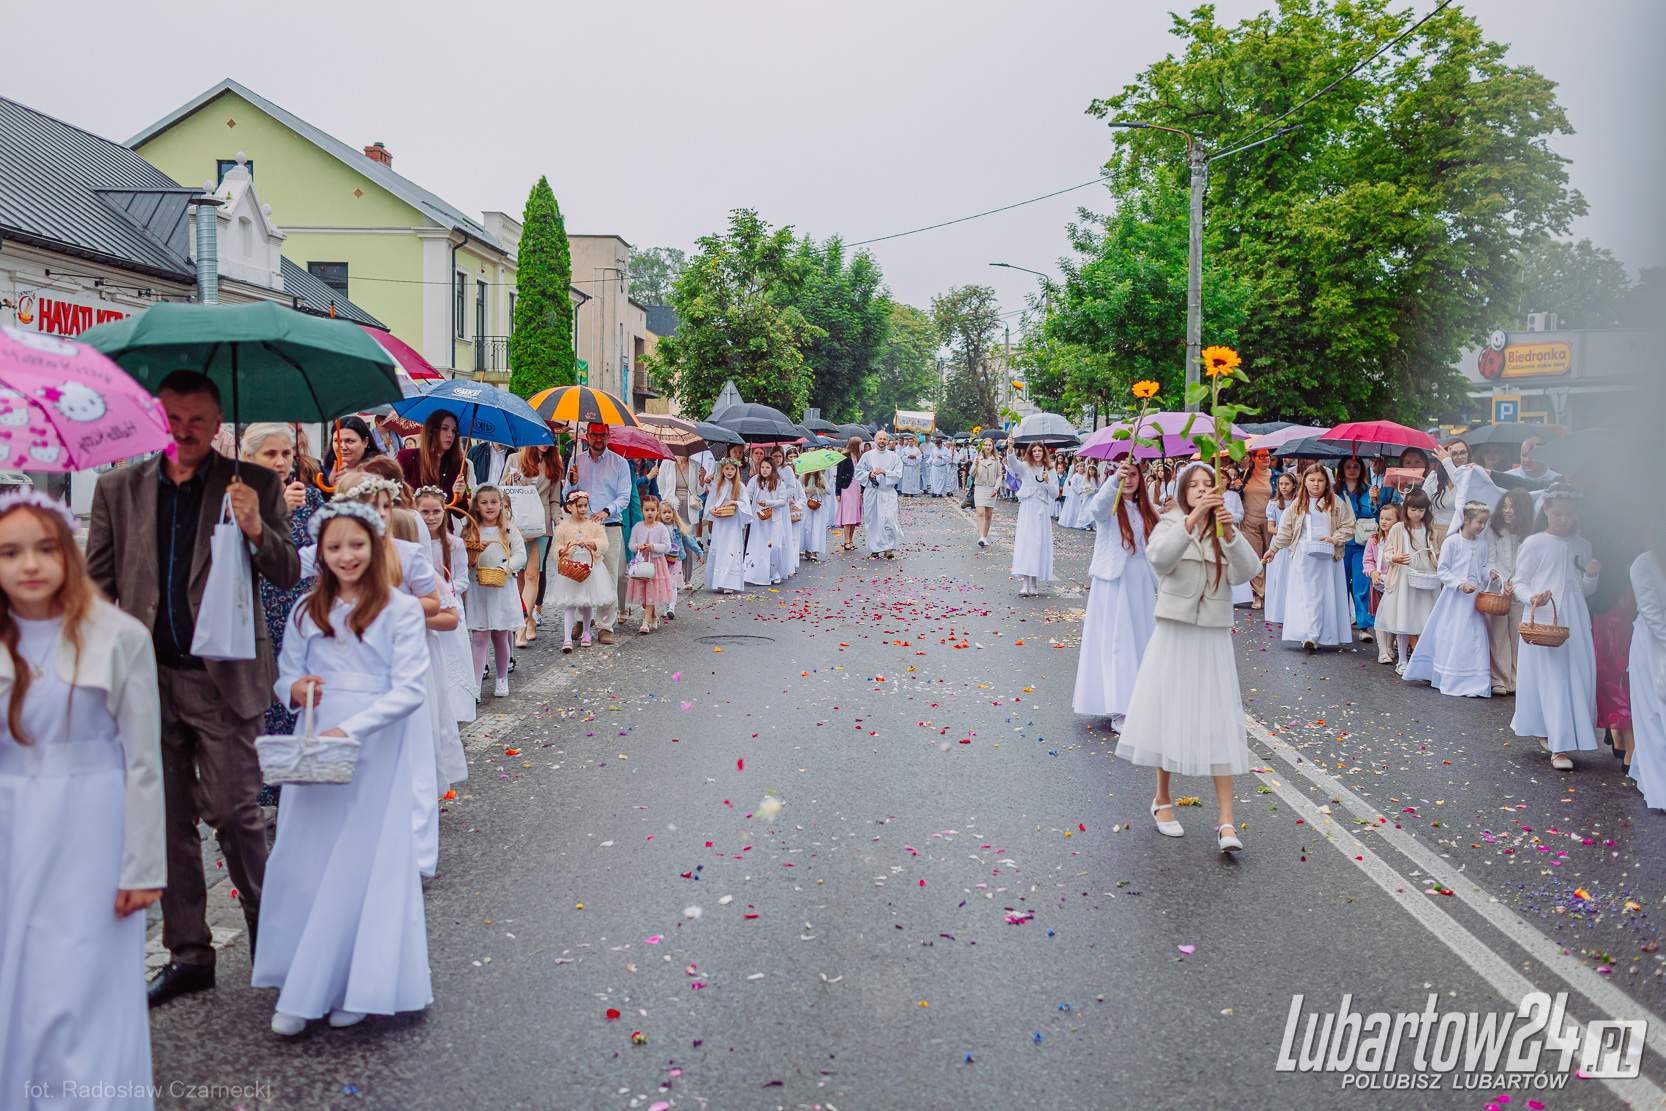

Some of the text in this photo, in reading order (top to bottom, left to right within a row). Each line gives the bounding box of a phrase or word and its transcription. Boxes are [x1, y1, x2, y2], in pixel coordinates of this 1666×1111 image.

[38, 298, 94, 336] HAYATI
[1508, 348, 1566, 362] Biedronka
[1501, 403, 1514, 420] P
